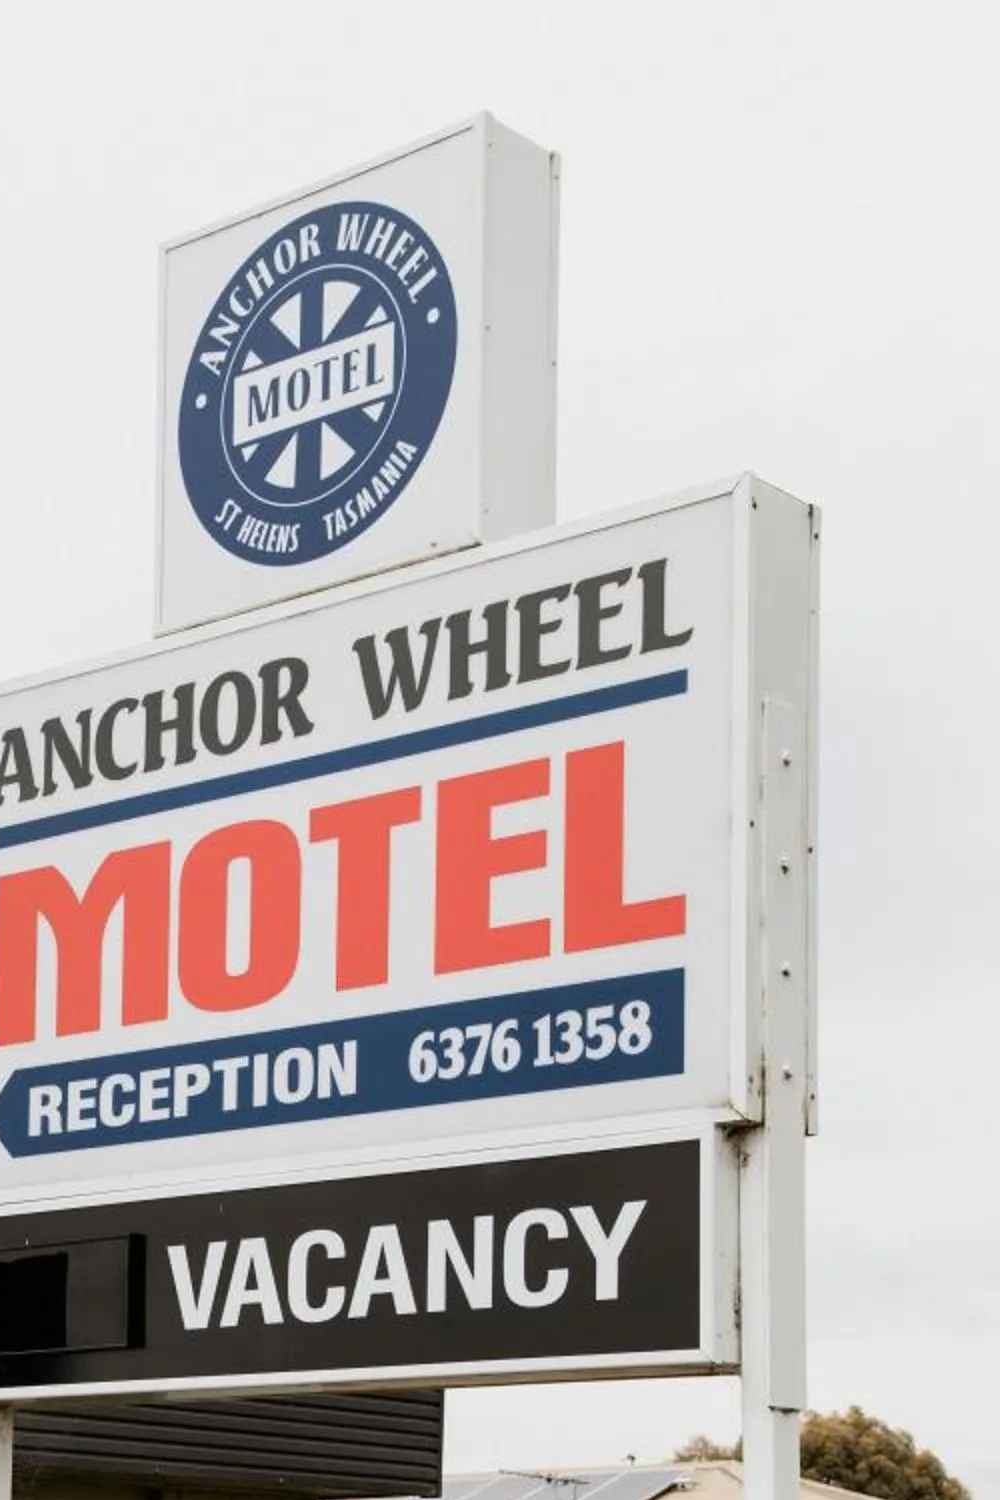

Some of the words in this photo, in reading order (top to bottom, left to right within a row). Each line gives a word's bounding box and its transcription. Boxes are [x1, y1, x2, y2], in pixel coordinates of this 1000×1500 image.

[199, 222, 322, 378] ANCHOR
[336, 212, 441, 305] WHEEL
[246, 342, 385, 428] MOTEL
[214, 499, 242, 527] ST
[237, 514, 302, 554] HELENS
[322, 439, 419, 542] TASMANIA
[351, 556, 695, 723] WHEEL
[27, 1039, 359, 1138] RECEPTION
[407, 1017, 522, 1084] 6376
[532, 1000, 654, 1069] 1358
[166, 1199, 648, 1332] VACANCY
